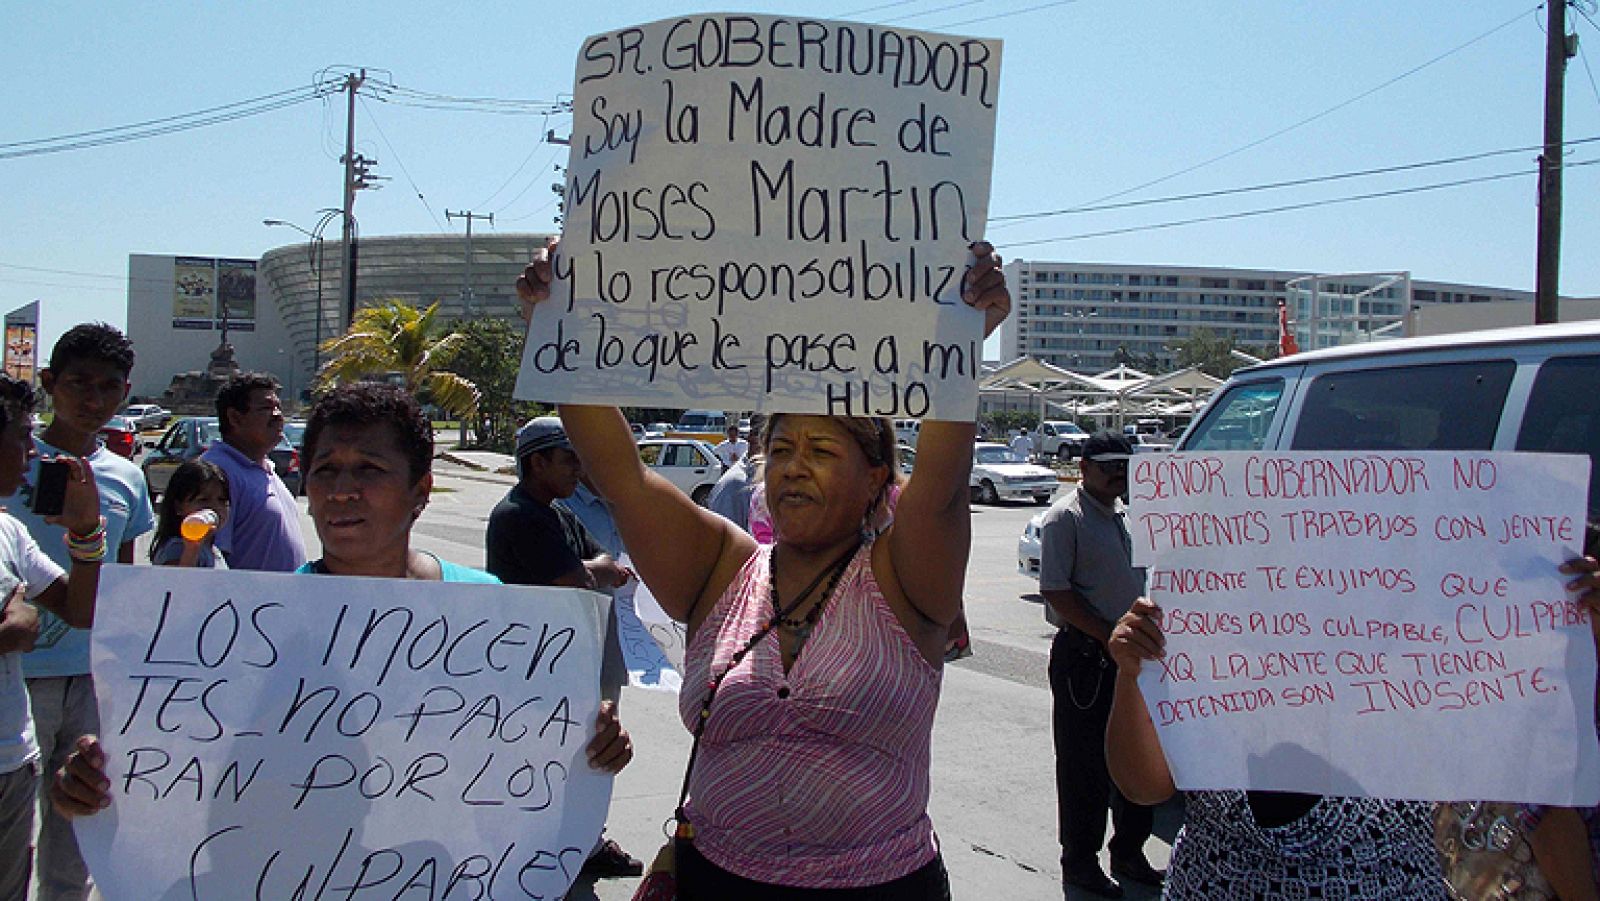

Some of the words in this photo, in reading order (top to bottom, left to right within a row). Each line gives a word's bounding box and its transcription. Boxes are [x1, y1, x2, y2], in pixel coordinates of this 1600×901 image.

[579, 28, 653, 84] SR.
[662, 17, 992, 109] GOBERNADOR
[583, 96, 642, 163] Soy
[663, 79, 698, 144] la
[728, 77, 878, 149] Madre
[899, 103, 951, 157] de
[566, 168, 716, 245] Moises
[751, 159, 971, 244] Martin
[593, 250, 631, 303] lo
[534, 319, 581, 374] de
[592, 312, 624, 371] lo
[632, 331, 699, 383] que
[711, 317, 758, 371] le
[766, 333, 857, 394] pase
[873, 335, 899, 375] a
[922, 340, 977, 381] mi
[826, 380, 930, 418] HIJO
[1245, 455, 1430, 499] GOBERNADOR
[1453, 456, 1498, 491] NO
[1281, 510, 1418, 542] TRABAJOS
[1434, 514, 1487, 541] CON
[1498, 514, 1573, 544] JENTE
[1150, 568, 1247, 594] INOCENTE
[1295, 564, 1417, 595] EXIJIMOS
[1440, 573, 1508, 598] QUE
[143, 591, 285, 669] LOS
[1157, 609, 1243, 636] USQUES
[1159, 652, 1196, 682] XQ
[1335, 651, 1388, 675] QUE
[1402, 650, 1506, 677] TIENEN
[122, 747, 264, 800] RAN
[290, 752, 450, 810] POR
[461, 752, 568, 811] LOS
